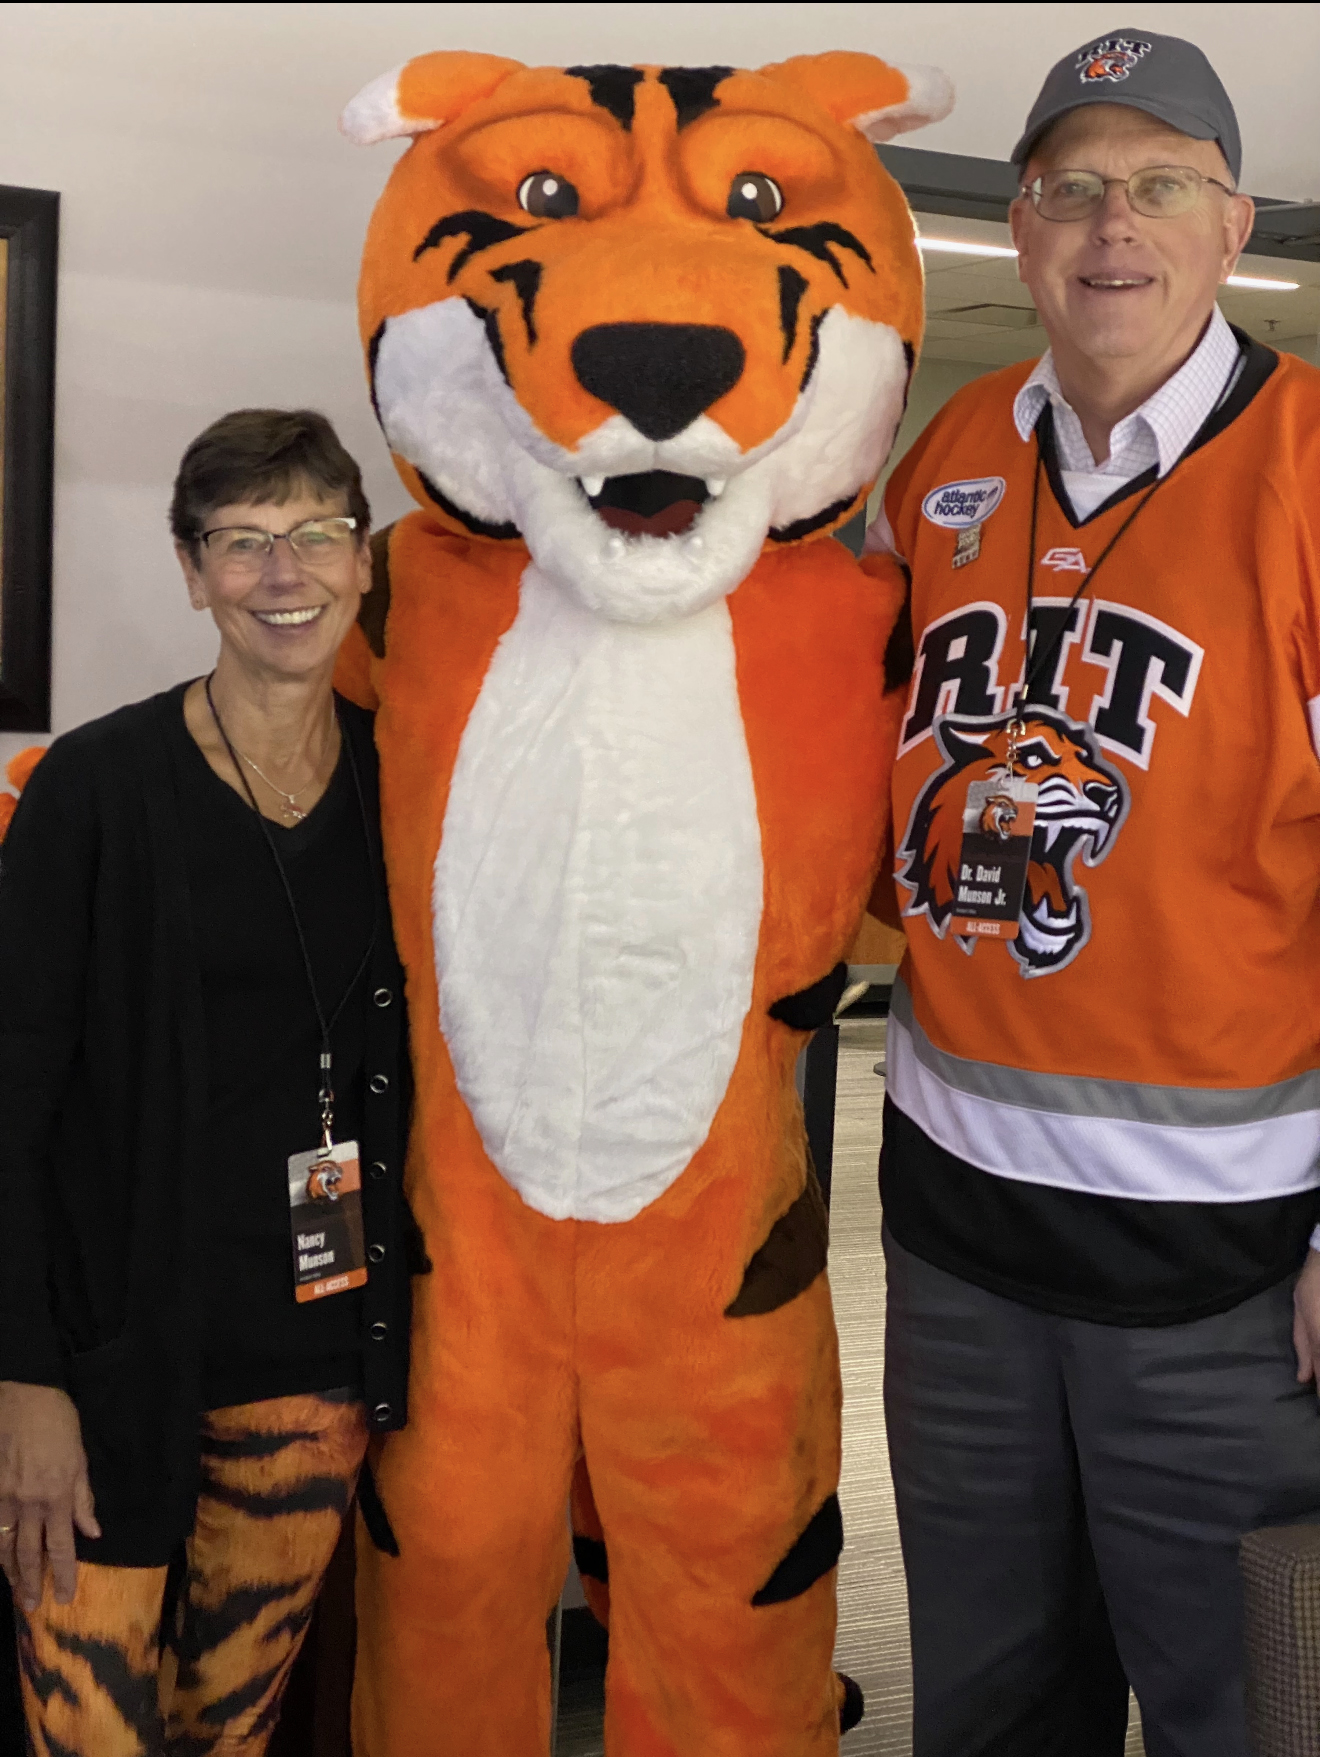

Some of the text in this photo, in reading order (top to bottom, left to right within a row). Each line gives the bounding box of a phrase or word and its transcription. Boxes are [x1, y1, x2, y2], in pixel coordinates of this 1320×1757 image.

[1075, 39, 1152, 69] RIT
[940, 489, 987, 505] atlantic
[933, 501, 980, 519] hockey
[896, 597, 1205, 771] RIT
[961, 864, 1001, 882] Dr. David
[958, 885, 1006, 906] Munson Jr.
[297, 1232, 326, 1250] Nancy
[299, 1250, 334, 1272] Munson
